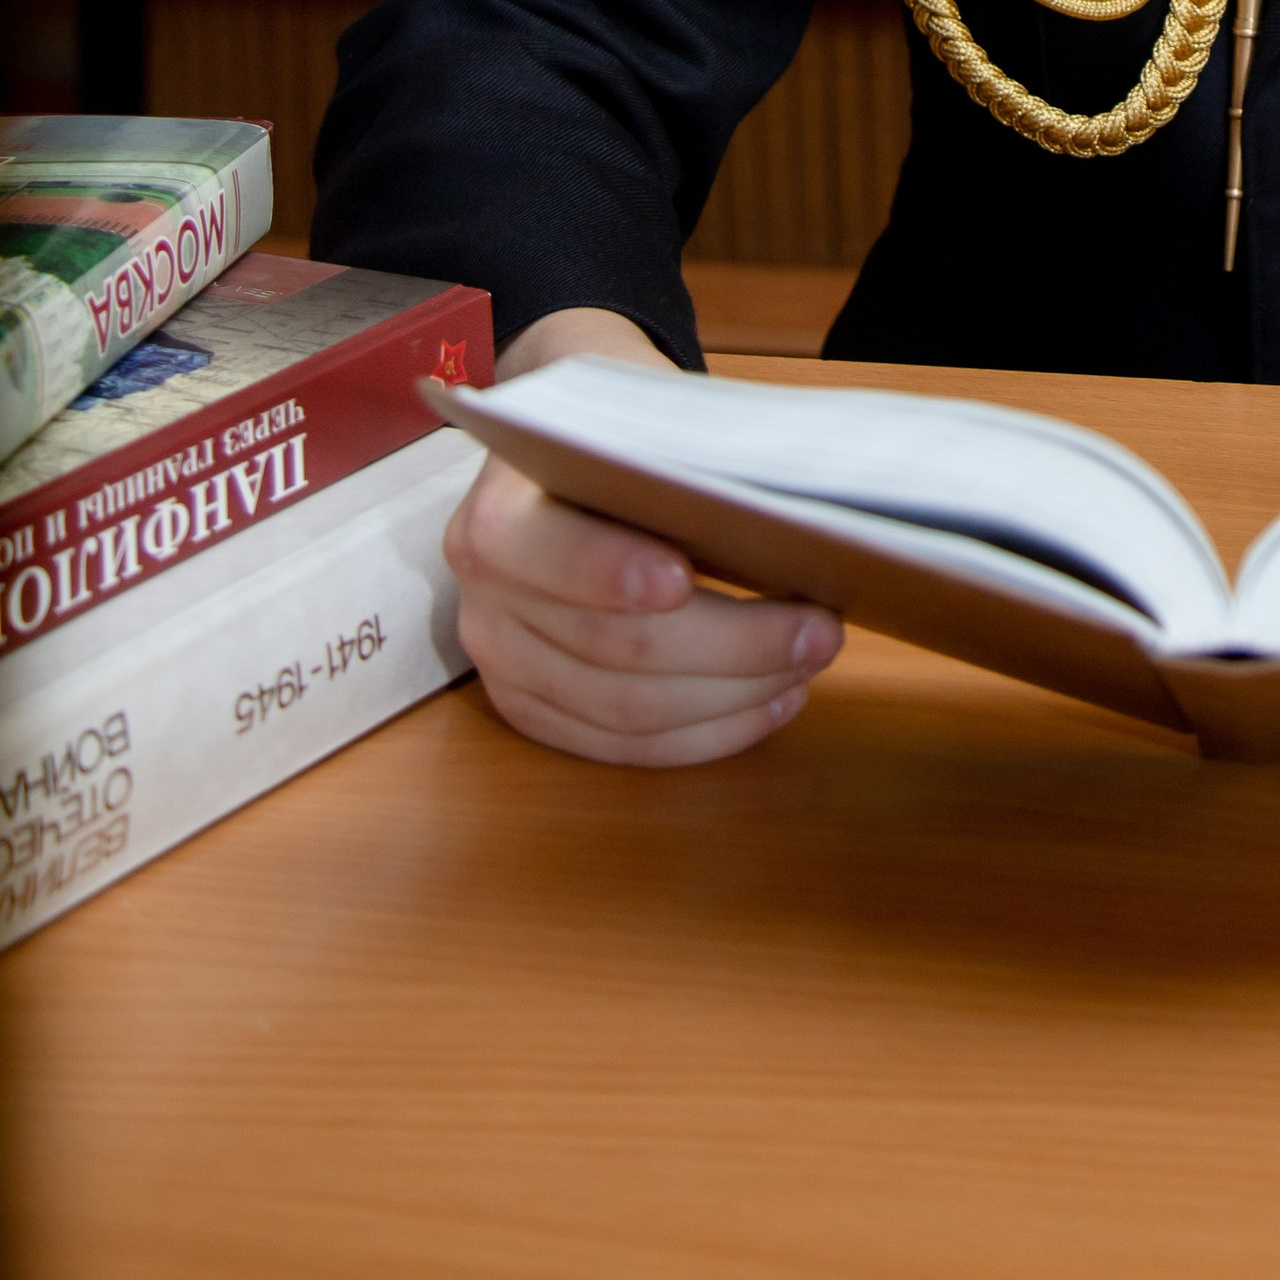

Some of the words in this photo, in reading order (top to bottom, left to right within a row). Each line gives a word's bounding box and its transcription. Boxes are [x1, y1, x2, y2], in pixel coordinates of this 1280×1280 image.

[86, 189, 225, 355] МОСКВА
[222, 397, 306, 456] ЧЕРЕЗ
[45, 508, 67, 546] И
[76, 436, 214, 530] ГРАНИЦЫ
[234, 613, 388, 736] 1941-1945
